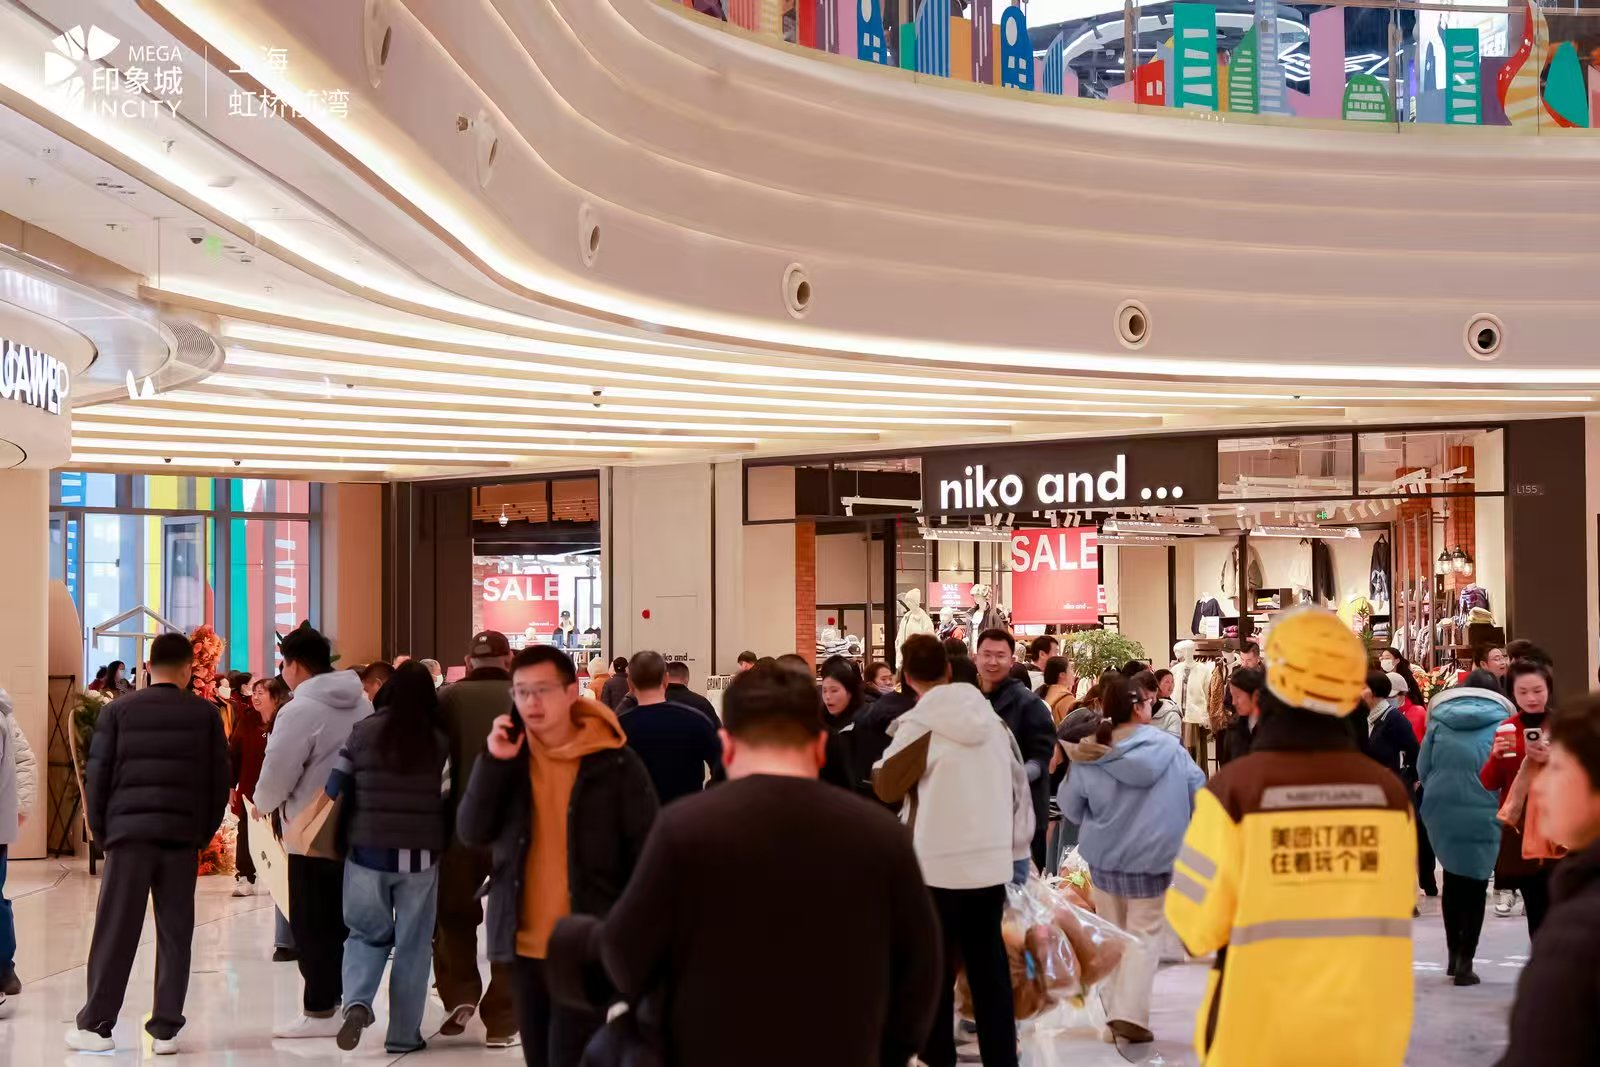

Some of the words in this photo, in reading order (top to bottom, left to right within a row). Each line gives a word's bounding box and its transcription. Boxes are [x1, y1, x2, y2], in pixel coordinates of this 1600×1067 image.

[940, 465, 1023, 509] niko
[1037, 454, 1126, 504] and
[1516, 485, 1538, 494] L155
[1011, 532, 1098, 572] SALE
[483, 576, 559, 601] SALE
[674, 652, 687, 661] and
[1271, 825, 1378, 848] 美团订酒店
